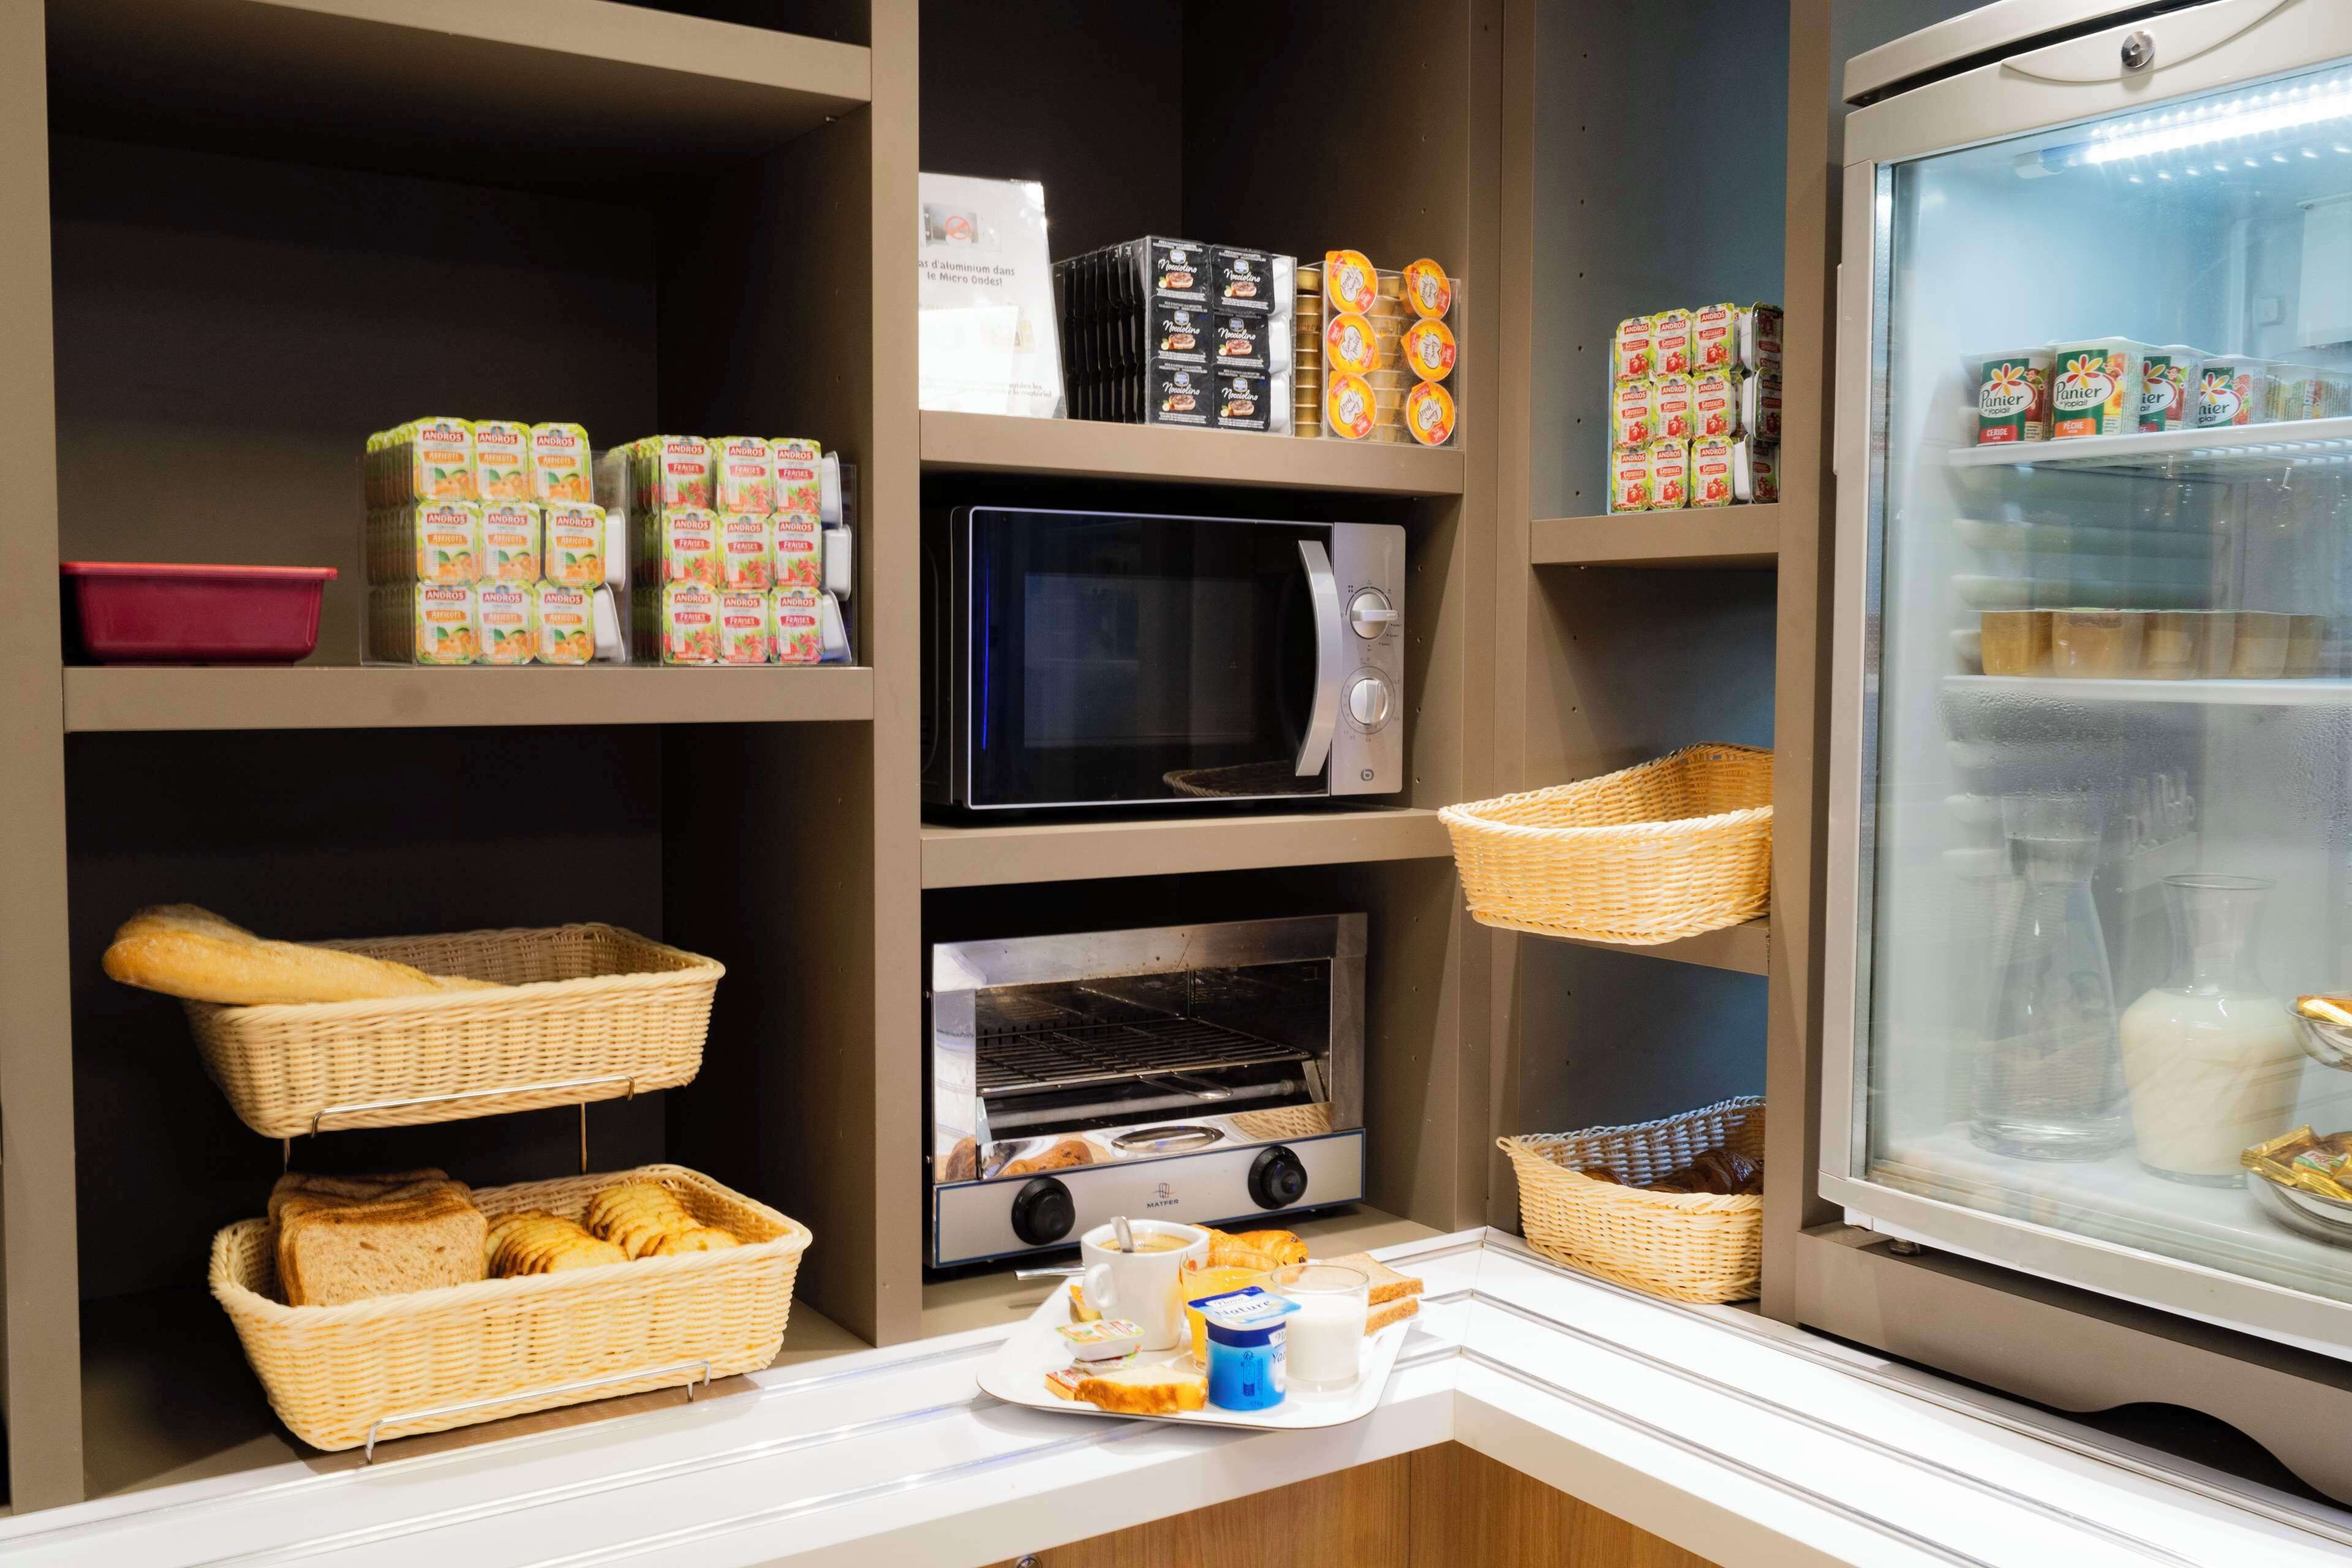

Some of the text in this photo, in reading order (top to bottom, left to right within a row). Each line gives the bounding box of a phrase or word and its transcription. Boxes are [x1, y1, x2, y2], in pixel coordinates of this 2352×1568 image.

[932, 260, 990, 273] d'aluminium
[993, 265, 1014, 276] dans
[1158, 258, 1197, 273] Nocciolino
[940, 273, 968, 284] Micro
[971, 276, 1002, 287] Ondes!
[1224, 268, 1261, 282] Nocciolino
[1163, 320, 1200, 334] Nocciolino
[1218, 327, 1256, 340] Nocciolino
[1163, 382, 1200, 395] Nocciolino
[2056, 382, 2102, 401] Panier
[1222, 387, 1258, 401] Nocciolino
[1981, 390, 2024, 409] Panier
[2064, 400, 2088, 409] yoplait
[1989, 407, 2010, 416] yoplait
[2063, 420, 2084, 431] PÊCHE
[424, 431, 461, 442] ANDROS
[480, 433, 515, 443] ANDROS
[538, 437, 573, 446] ANDROS
[669, 445, 702, 454] ANDROS
[730, 447, 763, 456] ANDROS
[779, 451, 811, 459] ANDROS
[735, 466, 760, 475] FRAISES
[429, 514, 464, 524] ANDROS
[489, 514, 524, 524] ANDROS
[557, 518, 592, 527] ANDROS
[780, 522, 812, 531] ANDROS
[428, 591, 464, 600] ANDROS
[484, 594, 520, 603] ANDROS
[546, 595, 581, 603] ANDROS
[1147, 1199, 1178, 1208] MATFER
[1215, 1300, 1270, 1316] Nature
